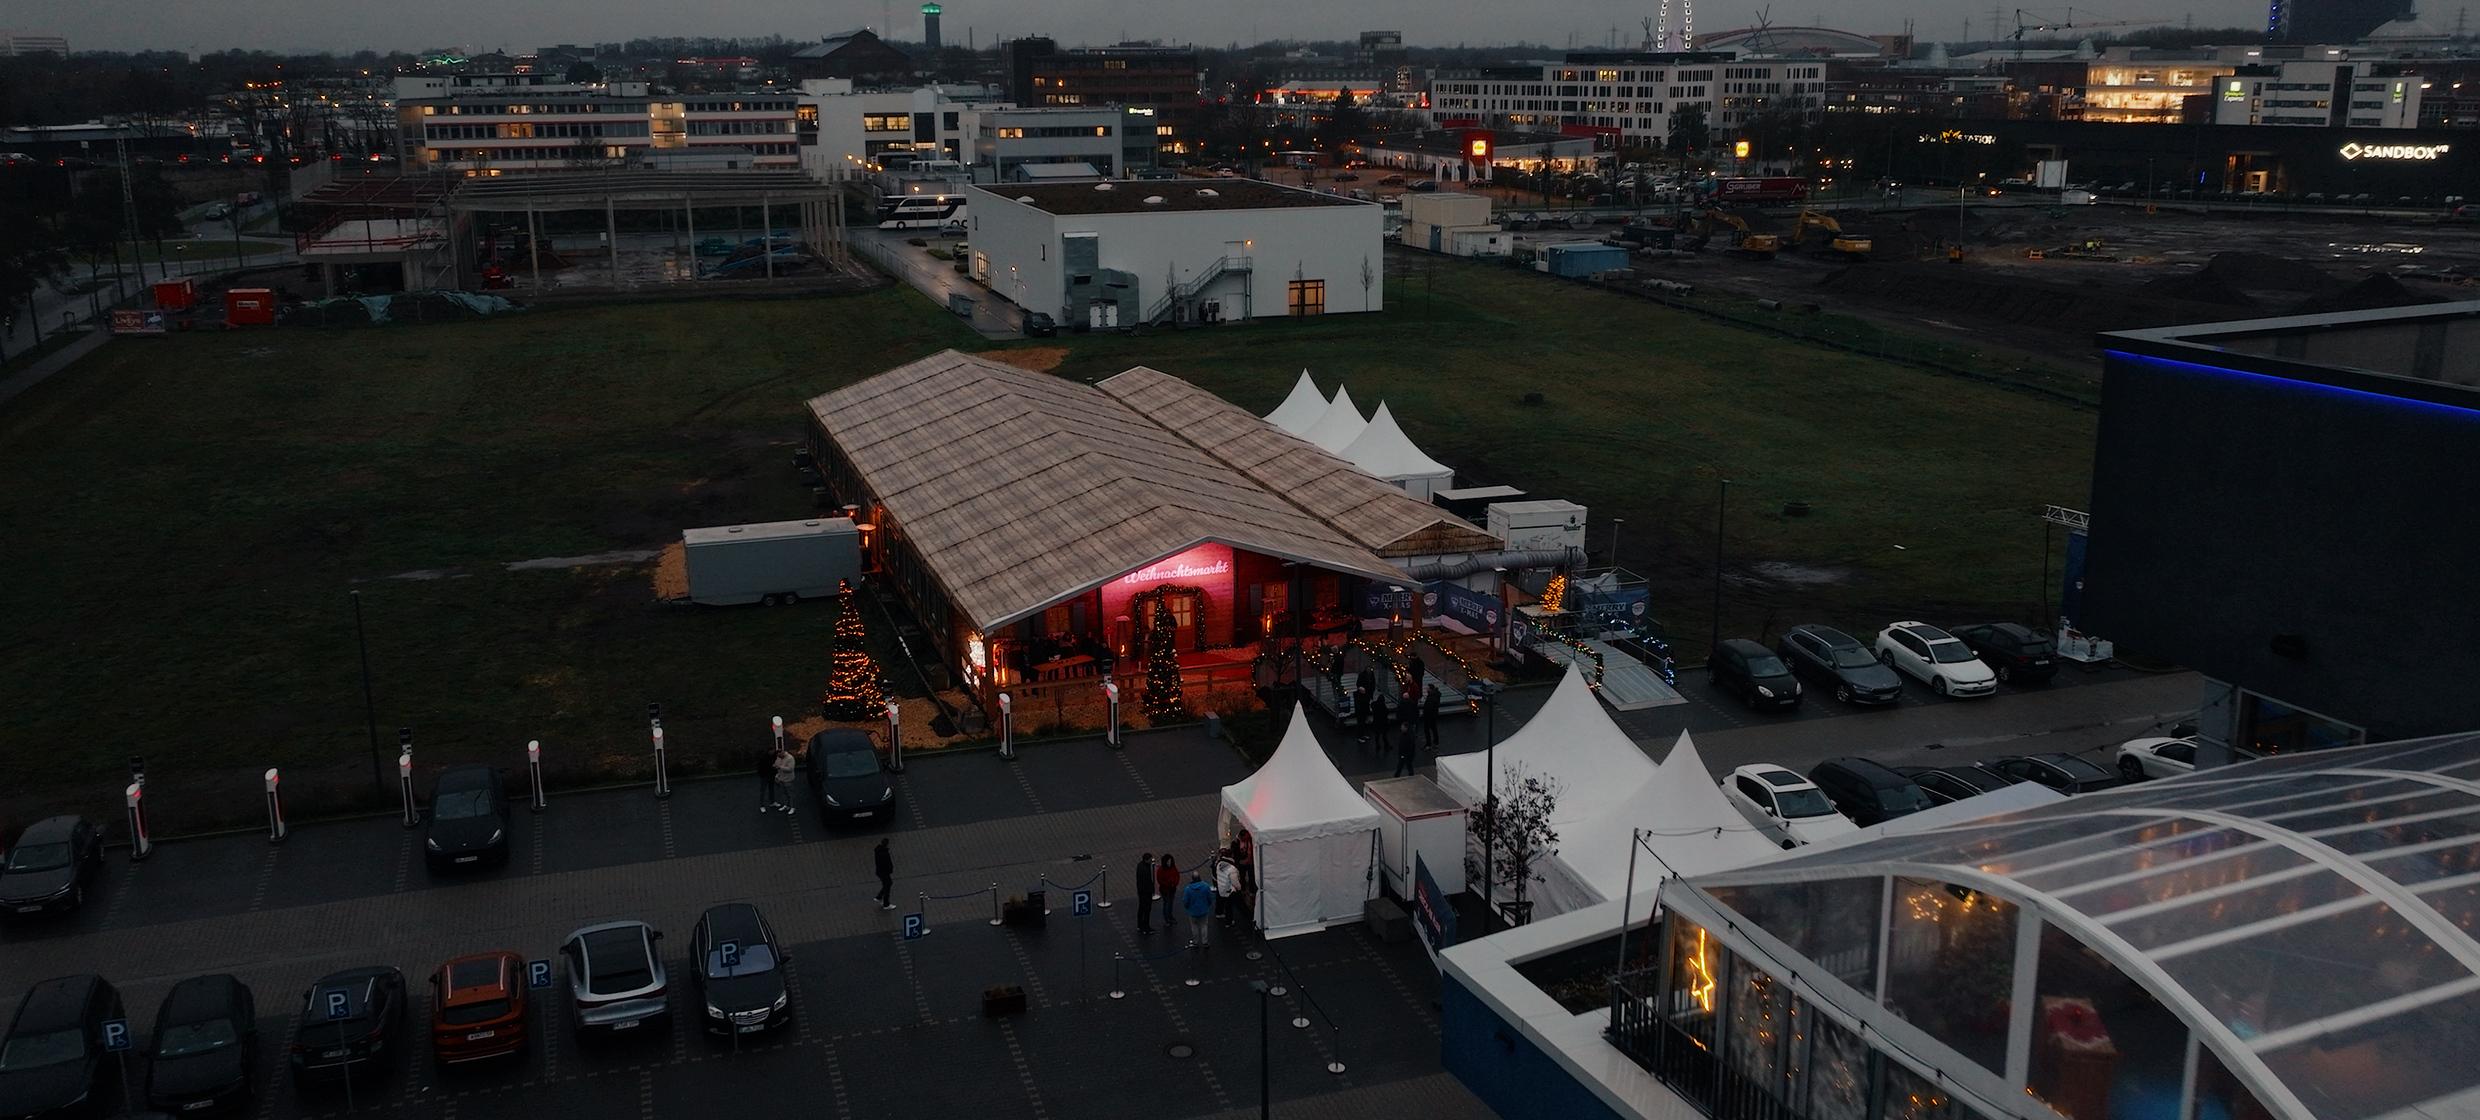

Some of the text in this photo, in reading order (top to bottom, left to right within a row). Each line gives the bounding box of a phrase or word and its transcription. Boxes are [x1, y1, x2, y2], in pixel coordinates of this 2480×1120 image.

[2363, 145, 2438, 160] SANDBOX
[1124, 560, 1229, 584] Weihnachtsmarkt
[1074, 893, 1090, 913] P
[905, 916, 920, 937] P
[721, 943, 737, 964] P
[531, 962, 548, 985] P
[328, 993, 346, 1016] P
[105, 1022, 126, 1047] P
